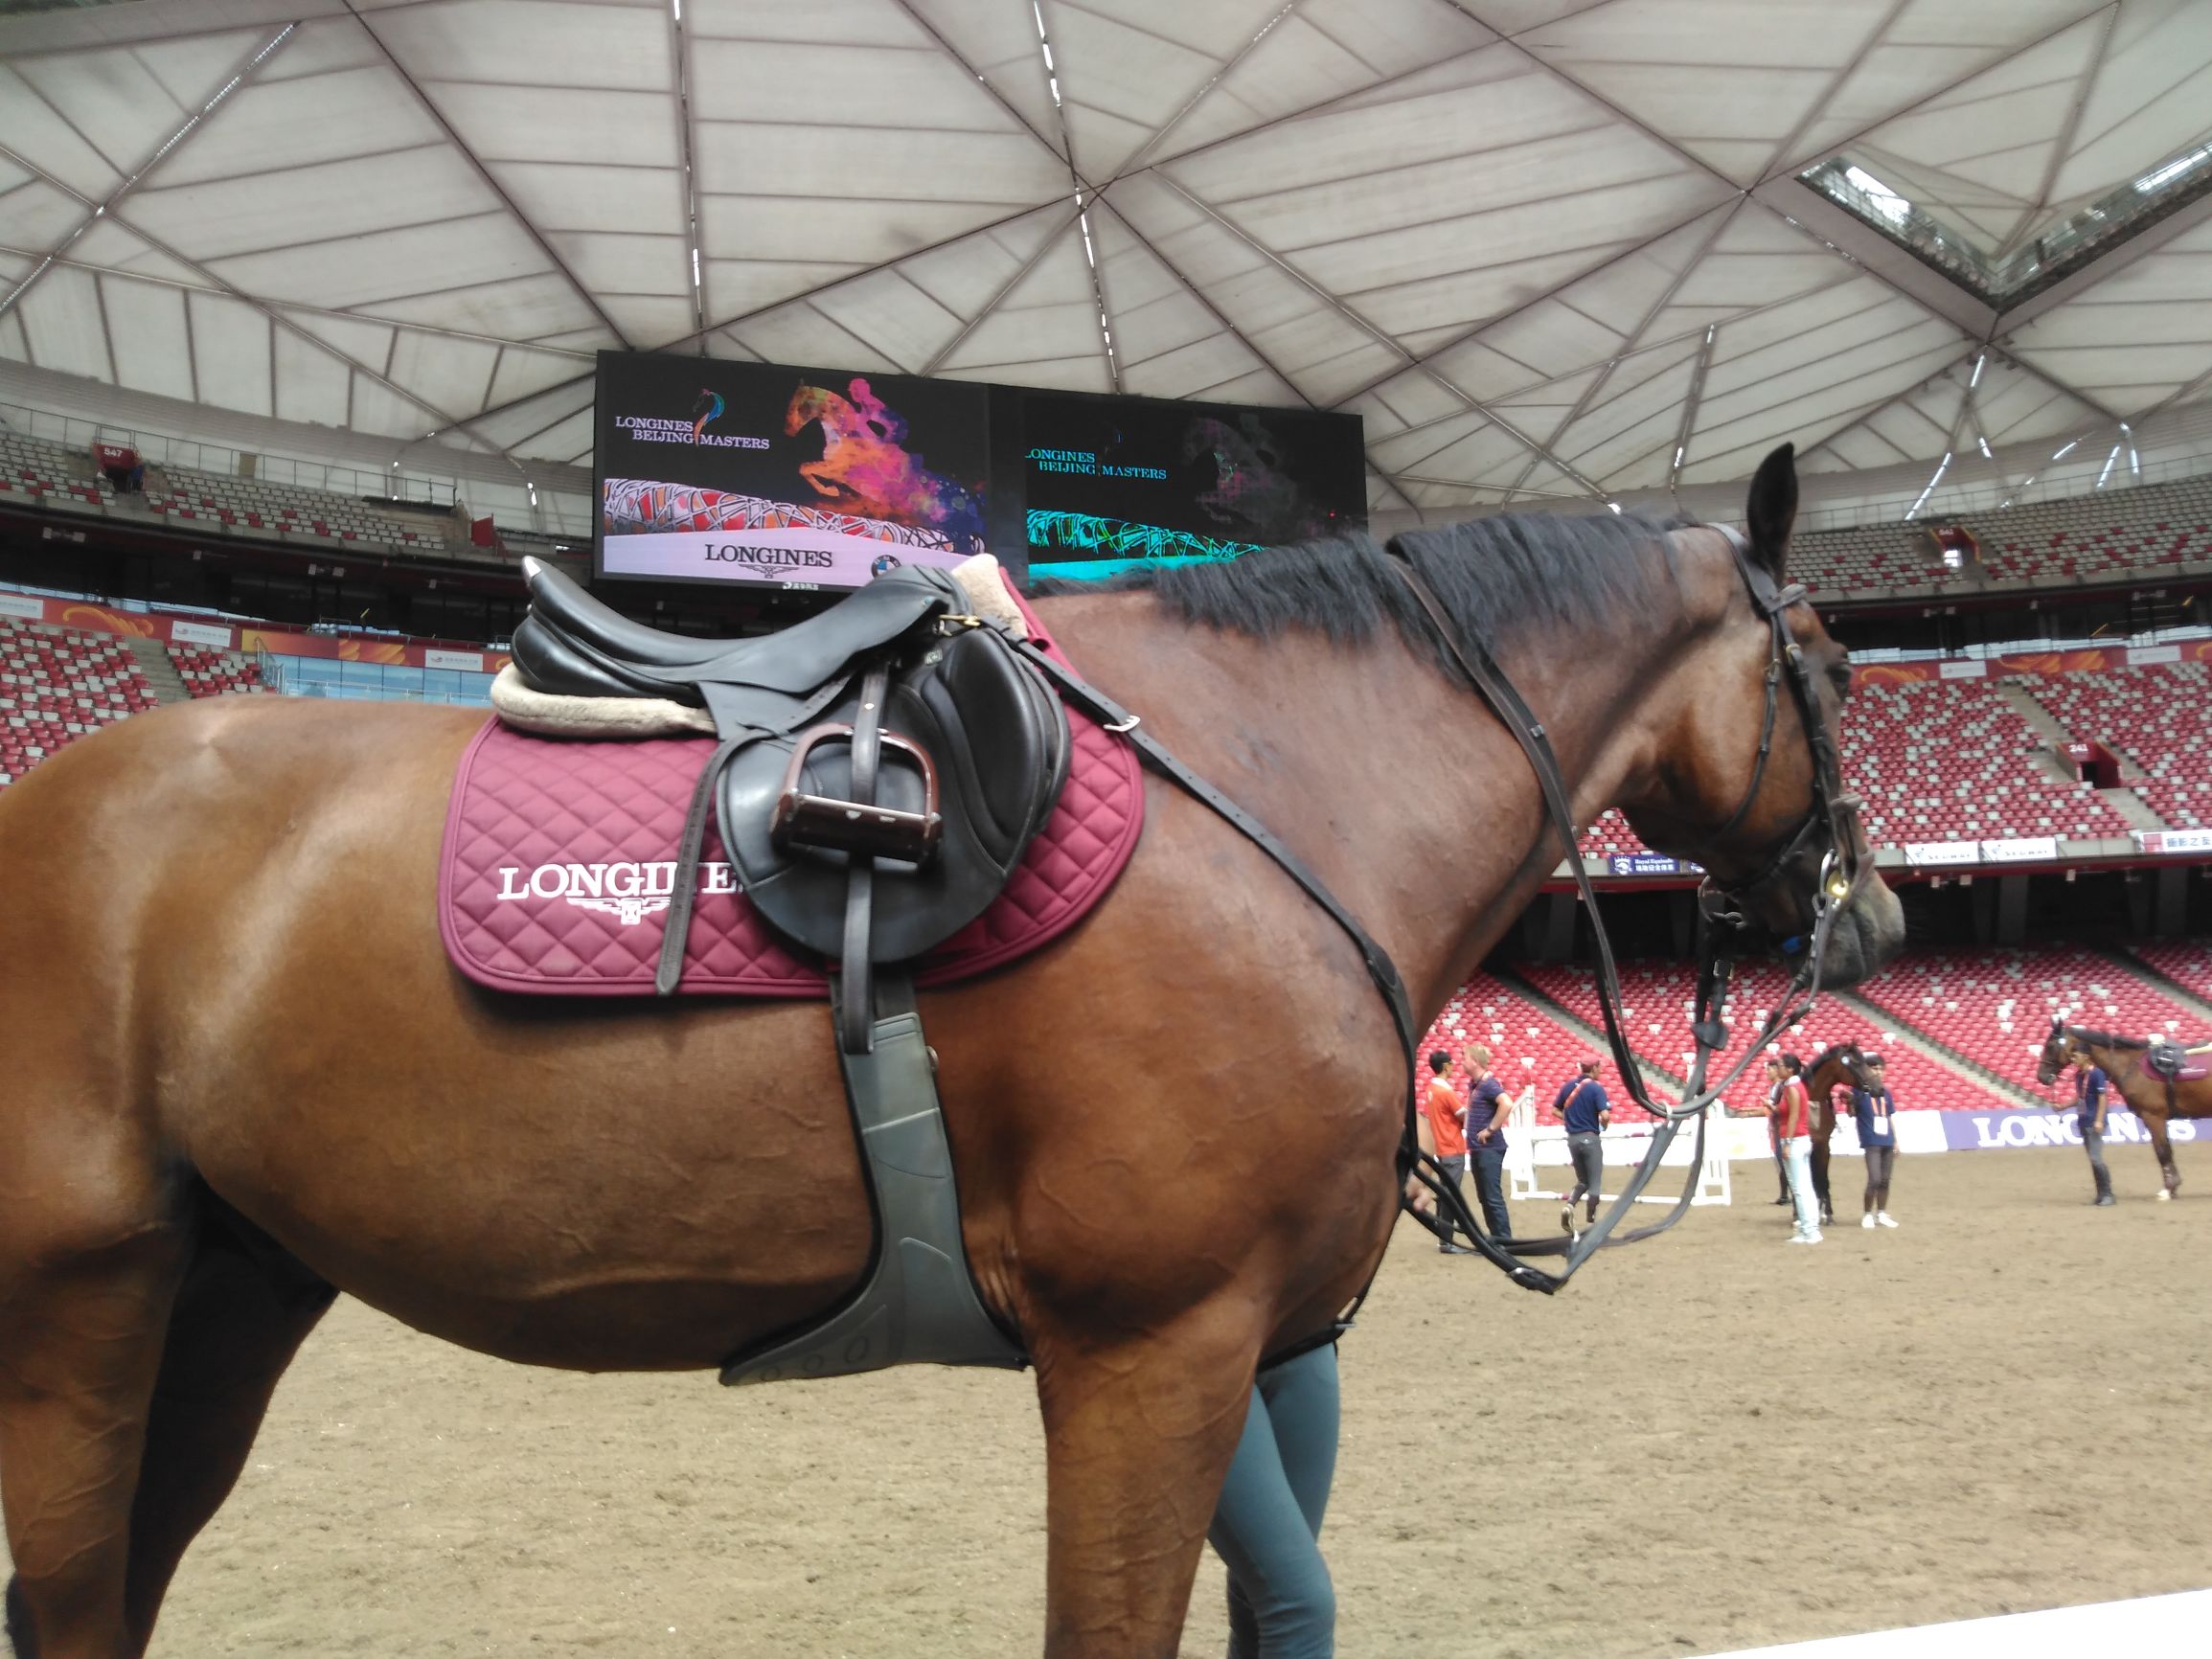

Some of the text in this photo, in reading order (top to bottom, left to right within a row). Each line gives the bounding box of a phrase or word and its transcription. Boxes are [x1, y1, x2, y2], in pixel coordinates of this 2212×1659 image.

[615, 416, 694, 432] LONGINES
[632, 429, 770, 450] BEIJING MASTERS
[1038, 461, 1167, 480] BEIJING MASTERS
[704, 543, 832, 568] LONGINES
[497, 861, 743, 899] LONGIE
[1973, 1111, 2196, 1148] LONGNS
